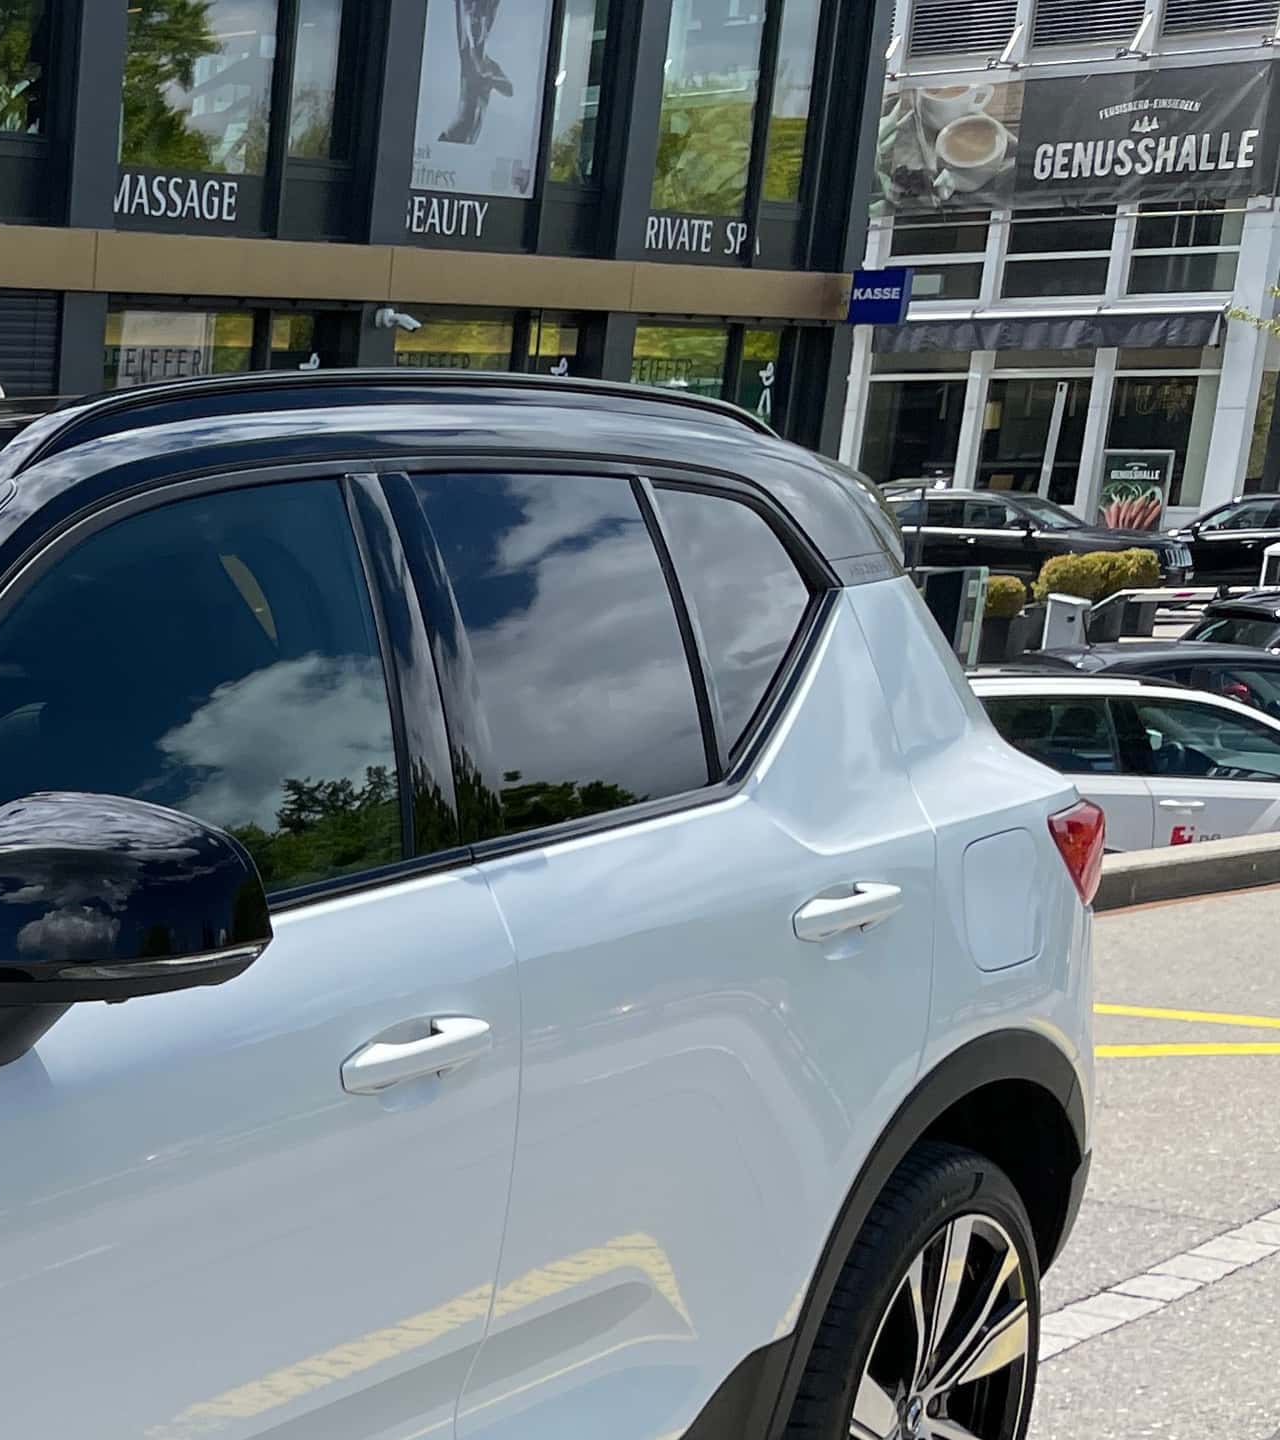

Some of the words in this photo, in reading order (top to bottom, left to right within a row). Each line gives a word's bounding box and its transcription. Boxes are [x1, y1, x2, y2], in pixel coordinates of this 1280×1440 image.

[1032, 128, 1260, 181] GENUSSHALLE
[112, 173, 239, 221] MASSAGE
[405, 195, 489, 237] EAUTY
[852, 287, 902, 301] KASSE
